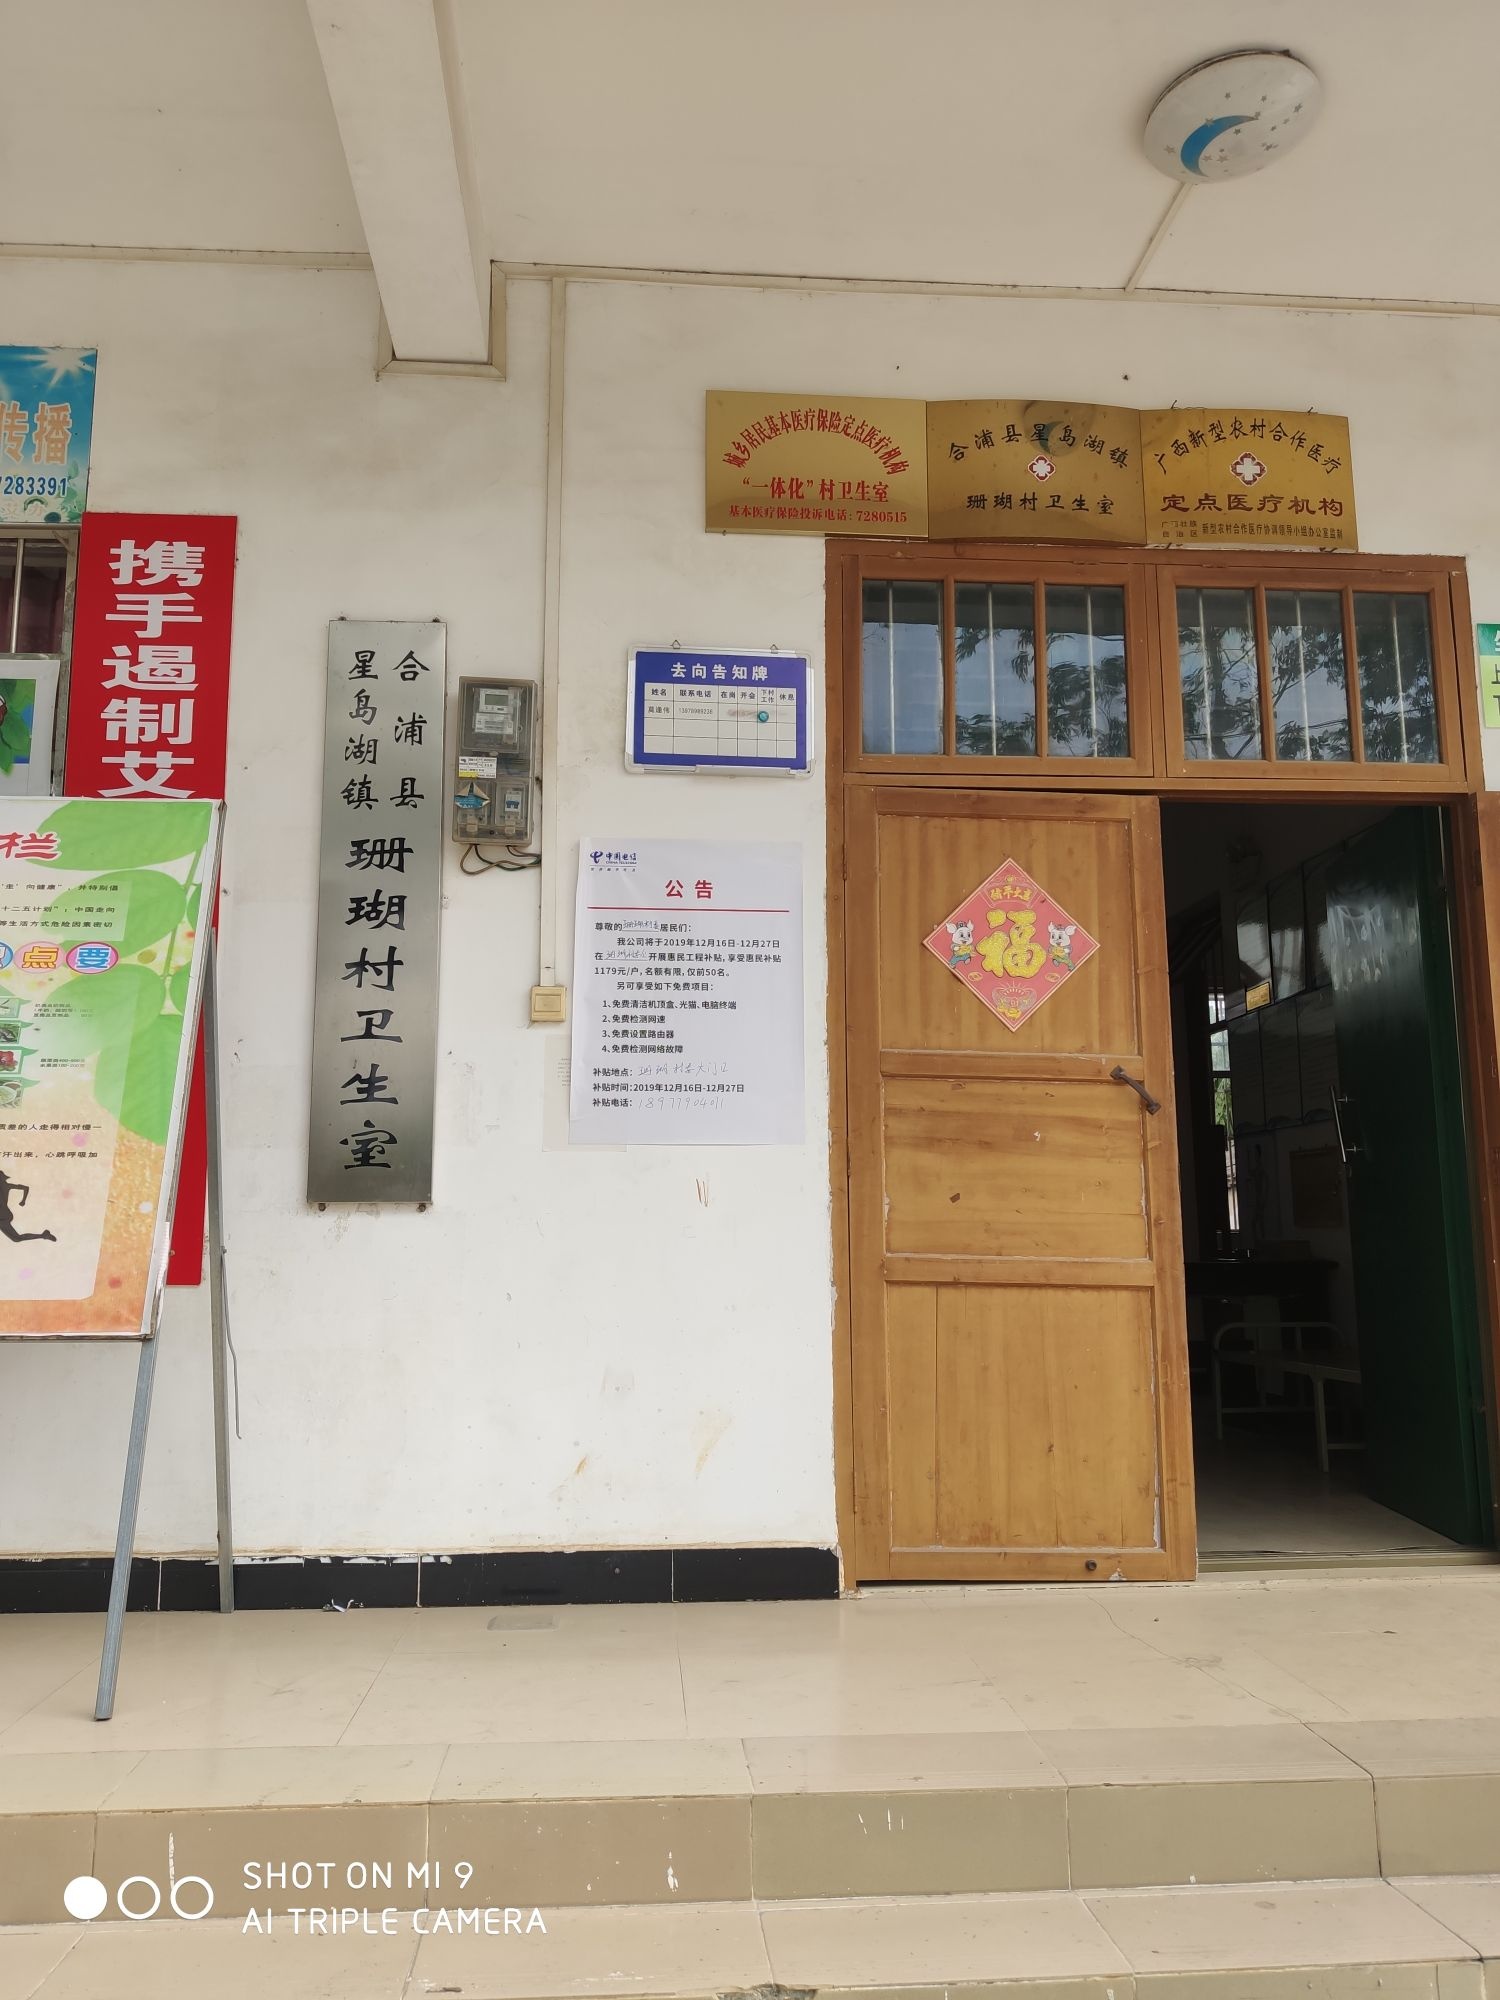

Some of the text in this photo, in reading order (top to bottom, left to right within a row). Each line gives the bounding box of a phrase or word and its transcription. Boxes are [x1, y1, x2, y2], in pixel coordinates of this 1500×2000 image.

[722, 407, 909, 475] 城乡居民基本医疗保险定点医疗机构
[948, 423, 1129, 468] 合浦县星岛湖镇
[1154, 417, 1341, 475] 广西新型农村合作医疗
[0, 476, 68, 496] 283391
[966, 492, 1115, 515] 珊瑚村卫生室
[1160, 494, 1344, 516] 定点医疗机构
[97, 539, 206, 800] 携手遏制艾
[670, 662, 769, 682] 去向告知牌
[651, 688, 668, 697] 姓名
[679, 689, 712, 698] 联系电话
[340, 650, 379, 811] 星岛湖镇
[389, 649, 431, 809] 合浦县
[605, 851, 637, 861] 中国电信
[665, 879, 714, 899] 公告
[976, 909, 1047, 979] 福
[339, 836, 415, 1171] 珊瑚村卫生室
